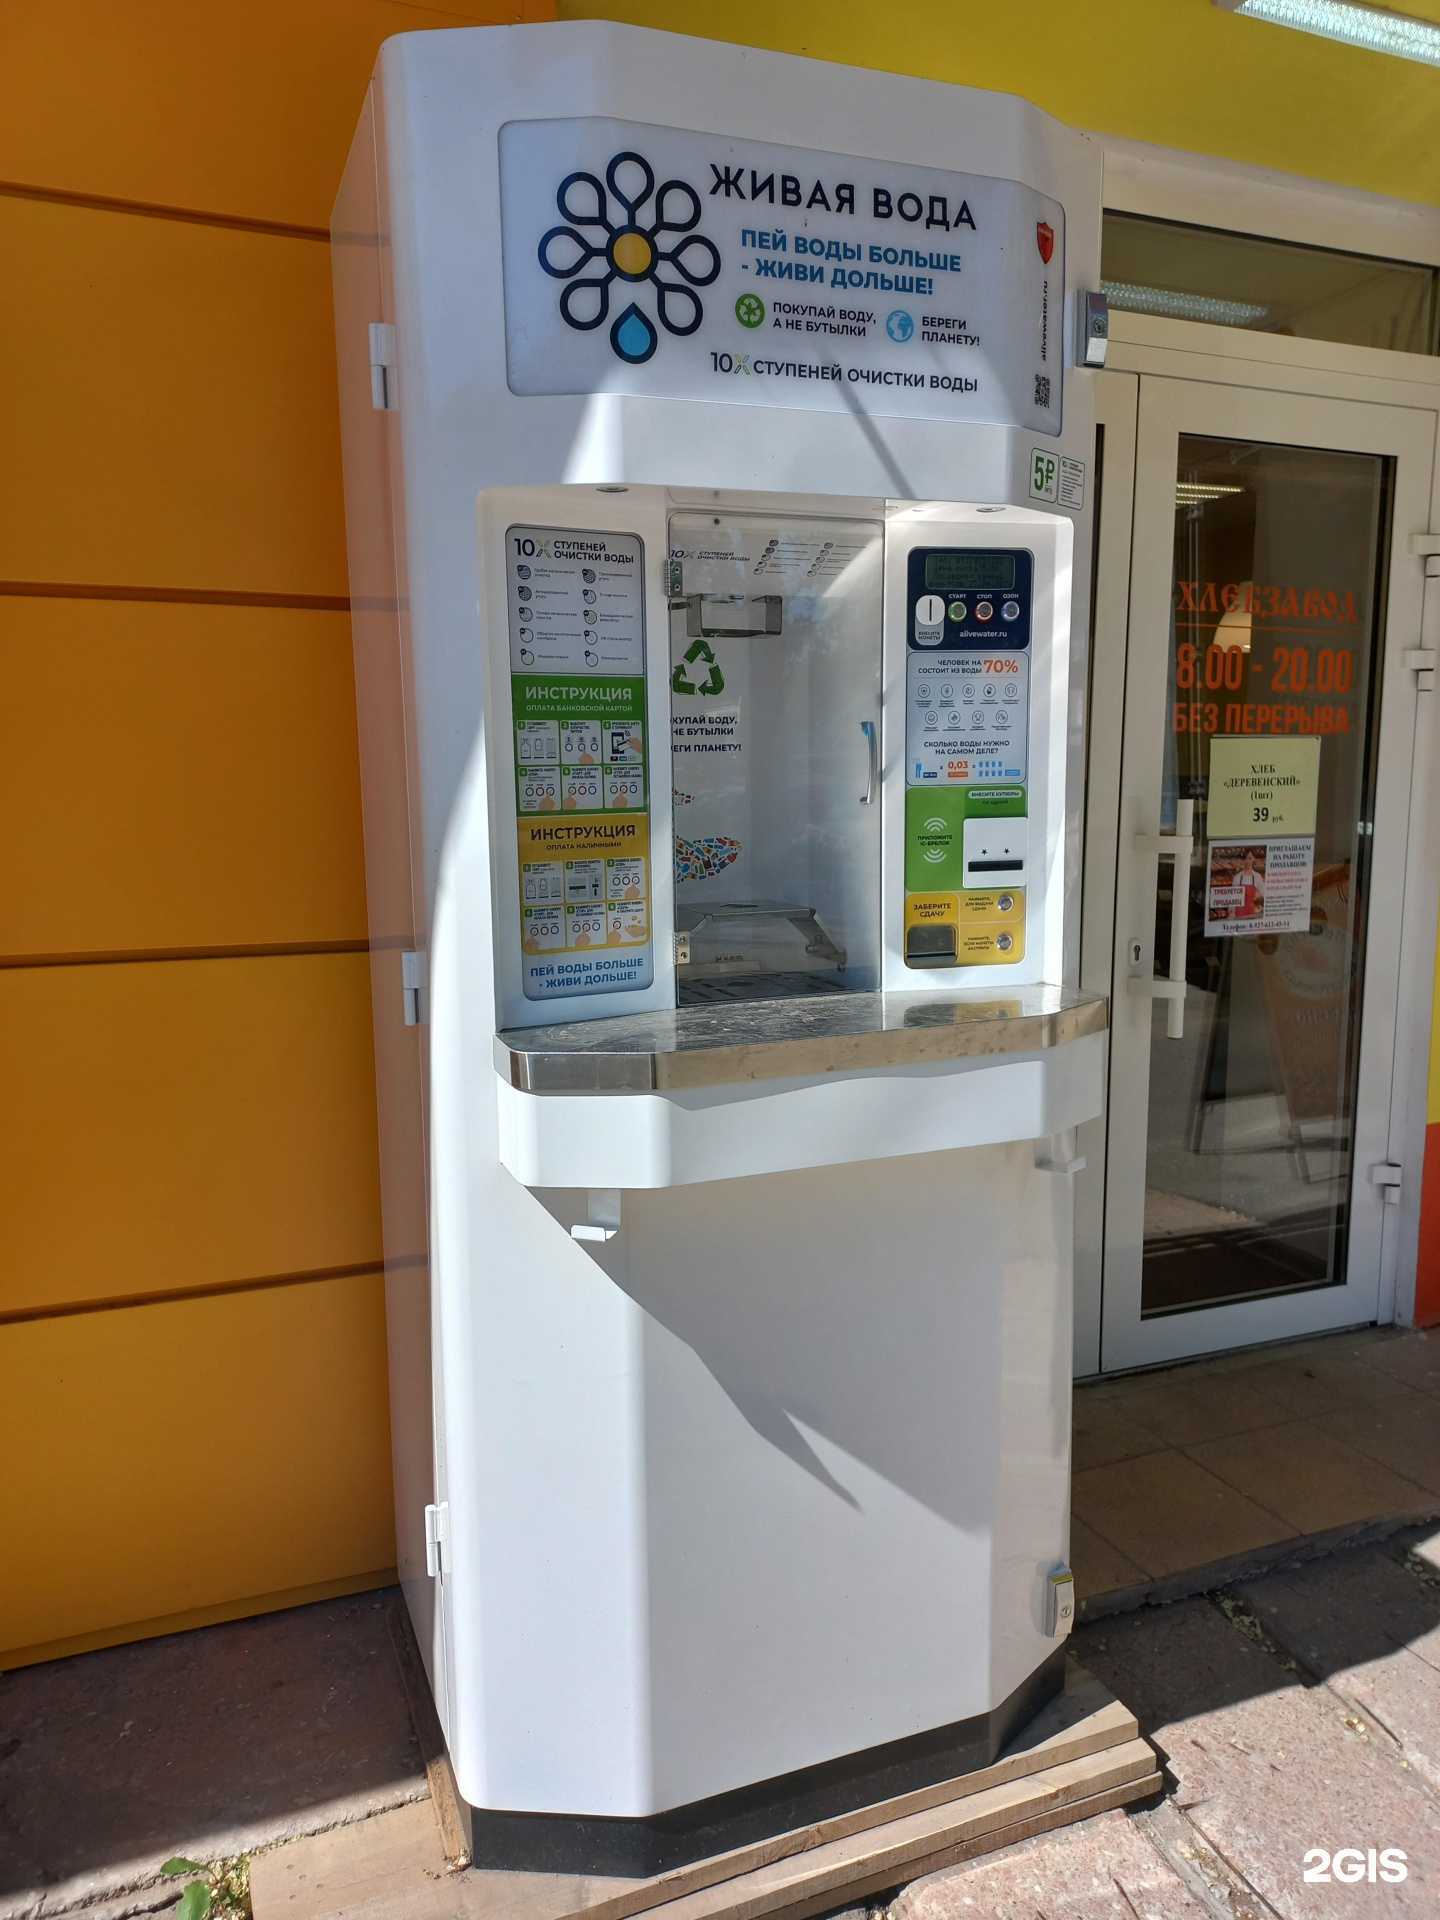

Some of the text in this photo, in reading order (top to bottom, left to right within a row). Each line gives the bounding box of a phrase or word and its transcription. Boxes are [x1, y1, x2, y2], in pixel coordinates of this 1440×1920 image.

[709, 163, 976, 232] ЖИВАЯ ВОДА
[741, 228, 961, 272] ПЕЙ ВОДЫ БОЛЬШЕ
[755, 258, 824, 284] ЖИВИ
[830, 268, 933, 295] ДОЛЬШЕ!
[773, 302, 877, 325] ПОКУПАЙ ВОДУ,
[773, 320, 867, 337] А НЕ БУТЫЛКИ
[922, 315, 967, 330] БЕРЕГИ
[921, 331, 980, 347] ПЛАНЕТУ!
[753, 359, 842, 382] СТУПЕНЕЙ
[848, 368, 925, 388] ОЧИСТКИ
[930, 376, 978, 393] ВОДЫ
[554, 540, 606, 552] СТУПЕНЕЙ
[554, 550, 634, 564] ОЧИСТКИ ВОДЫ
[983, 659, 1018, 674] 70%
[1176, 642, 1243, 691] 8.00
[1271, 647, 1353, 694] 20.00
[525, 686, 632, 702] ИНСТРУКЦИЯ
[526, 704, 555, 712] ОПЛАТА
[605, 705, 633, 713] КАРТОЙ
[1173, 703, 1349, 735] БЕЗ ПЕРЕРЫВА
[687, 728, 734, 736] БУТЫЛКИ
[694, 743, 742, 752] ПЛАНЕТУ!
[960, 740, 982, 748] ВОДЫ
[1251, 764, 1275, 773] ХЛЕБ
[1253, 807, 1269, 822] 39
[530, 824, 636, 841] ИНСТРУКЦИЯ
[546, 843, 574, 851] ОПЛАТА
[914, 902, 952, 911] ЗАБЕРИТЕ
[530, 958, 643, 977] ПЕЙ ВОДЫ БОЛЬШЕ
[546, 975, 582, 989] ЖИВИ
[584, 971, 637, 987] ДОЛЬШЕ!
